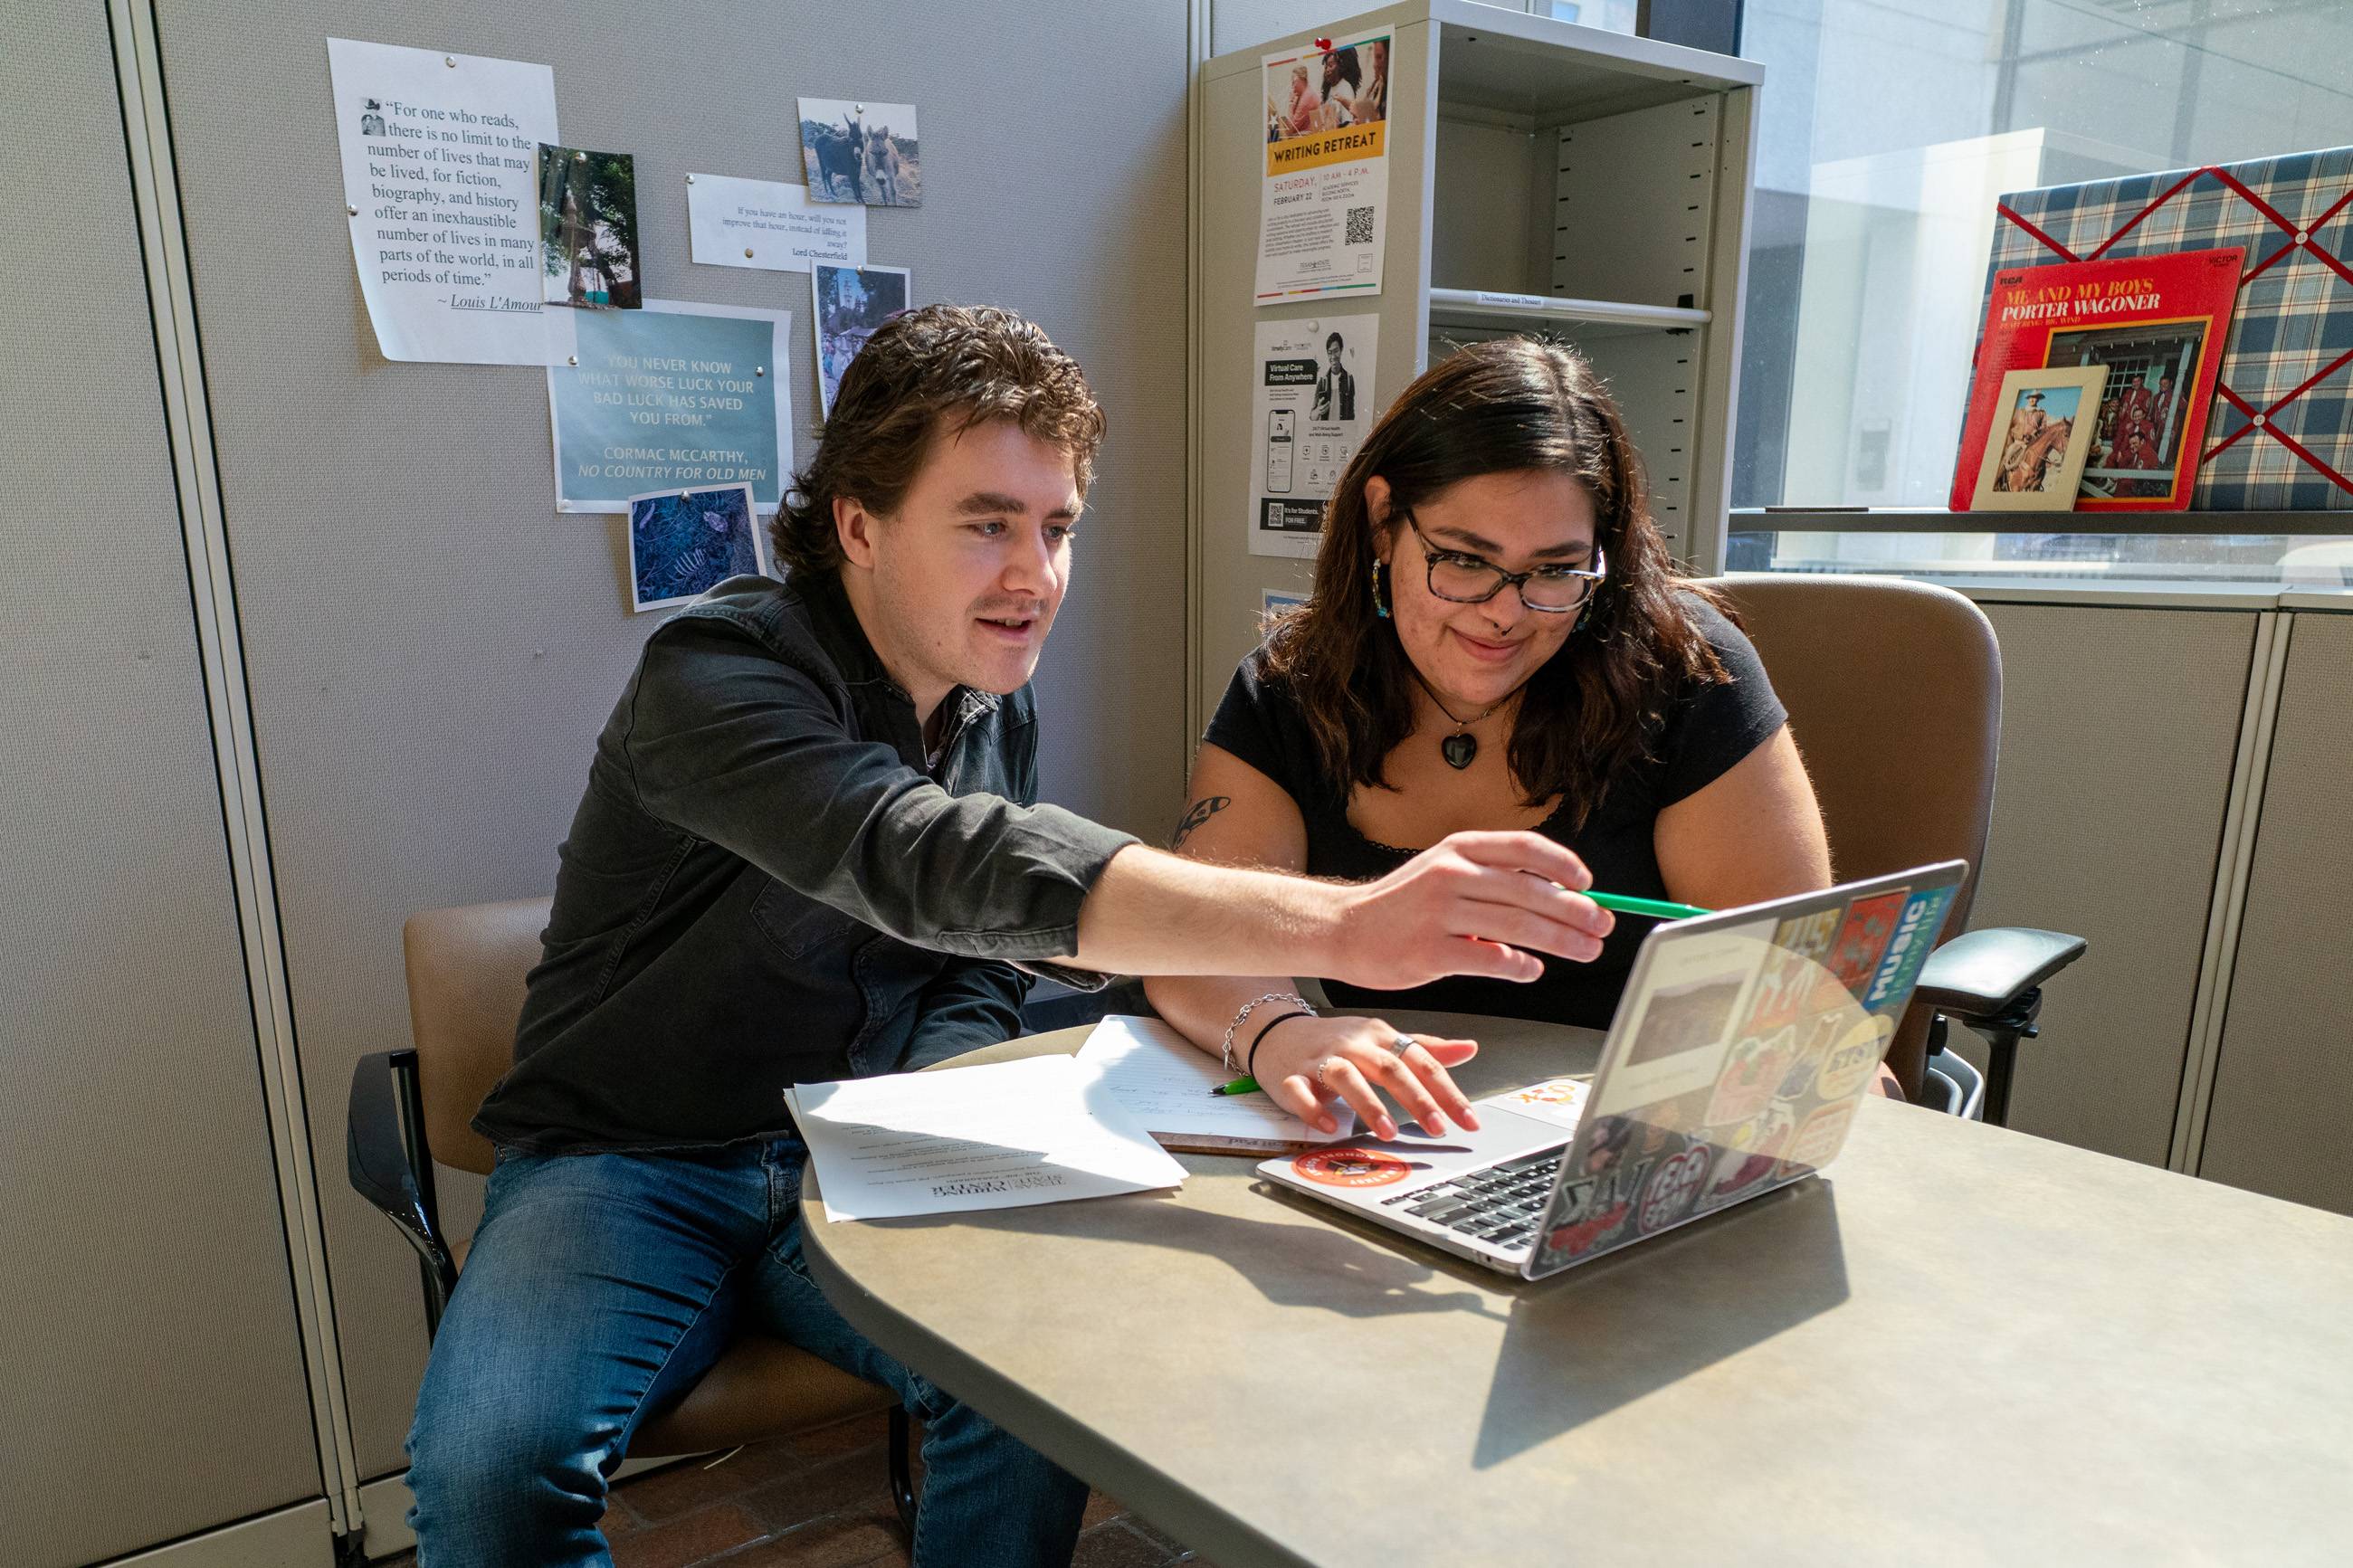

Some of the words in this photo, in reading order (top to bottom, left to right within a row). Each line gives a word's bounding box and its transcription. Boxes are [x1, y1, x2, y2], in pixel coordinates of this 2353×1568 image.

[422, 109, 444, 120] one
[449, 109, 477, 124] who
[481, 114, 519, 129] reads,
[389, 123, 422, 138] there
[427, 126, 438, 140] is
[442, 130, 458, 142] no
[462, 130, 492, 146] limit
[497, 136, 508, 147] to
[512, 137, 531, 150] the
[1273, 142, 1320, 163] WRITING
[1323, 132, 1377, 154] RETREAT
[367, 144, 419, 159] number
[424, 147, 439, 161] of
[442, 148, 472, 165] lives
[477, 152, 500, 167] that
[504, 157, 530, 173] may
[369, 163, 386, 177] be
[391, 165, 428, 181] lived,
[433, 168, 452, 182] for
[456, 170, 500, 188] fiction,
[1273, 176, 1318, 193] SATURDAY,
[372, 184, 444, 205] biography,
[449, 190, 472, 205] and
[476, 193, 519, 212] history
[1273, 193, 1303, 205] FEBRUARY
[375, 205, 408, 221] offer
[412, 211, 428, 222] an
[433, 208, 517, 229] inexhaustible
[738, 206, 744, 214] If
[745, 209, 758, 217] you
[760, 208, 776, 218] have
[778, 211, 786, 219] an
[788, 211, 806, 222] hour,
[808, 214, 821, 223] will
[822, 217, 834, 225] you
[722, 217, 751, 228] improve
[753, 220, 767, 229] that
[768, 221, 787, 232] hour,
[789, 225, 812, 233] instead
[814, 226, 822, 234] of
[377, 228, 428, 242] number
[433, 230, 448, 243] of
[452, 230, 481, 246] lives
[484, 233, 497, 247] in
[500, 238, 535, 253] many
[379, 250, 413, 263] parts
[416, 250, 432, 262] of
[434, 251, 454, 263] the
[458, 253, 499, 268] world,
[502, 254, 515, 268] in
[519, 256, 534, 269] all
[792, 248, 807, 257] Lord
[809, 249, 848, 261] Chesterfield
[382, 269, 432, 284] periods
[435, 270, 450, 284] of
[2006, 290, 2030, 305] ME
[2037, 286, 2072, 303] AND
[2077, 282, 2101, 299] MY
[2108, 278, 2155, 296] BOYS
[451, 294, 486, 309] Louis
[490, 296, 543, 312] L'Amour
[2001, 301, 2069, 323] PORTER
[2073, 293, 2161, 316] WAGONER
[643, 357, 687, 372] NEVER
[691, 360, 731, 375] KNOW
[1270, 364, 1290, 372] Virtual
[1290, 364, 1303, 372] Care
[577, 373, 619, 385] WHAT
[625, 375, 674, 390] WORSE
[679, 378, 713, 391] LUCK
[718, 380, 754, 394] YOUR
[1269, 374, 1283, 382] From
[1284, 373, 1313, 382] Anywhere
[594, 392, 622, 405] BAD
[627, 393, 663, 407] LUCK
[669, 396, 696, 408] HAS
[700, 397, 742, 411] SAVED
[630, 412, 660, 425] YOU
[604, 448, 665, 461] CORMAC
[669, 449, 748, 465] MCCARTHY,
[578, 465, 599, 477] NO
[605, 466, 672, 479] COUNTRY
[675, 467, 702, 479] FOR
[706, 468, 734, 480] OLD
[738, 469, 767, 480] MEN
[1869, 900, 1927, 1001] MUSIC
[931, 1181, 1005, 1193] CENTER
[934, 1186, 1006, 1198] WRITING
